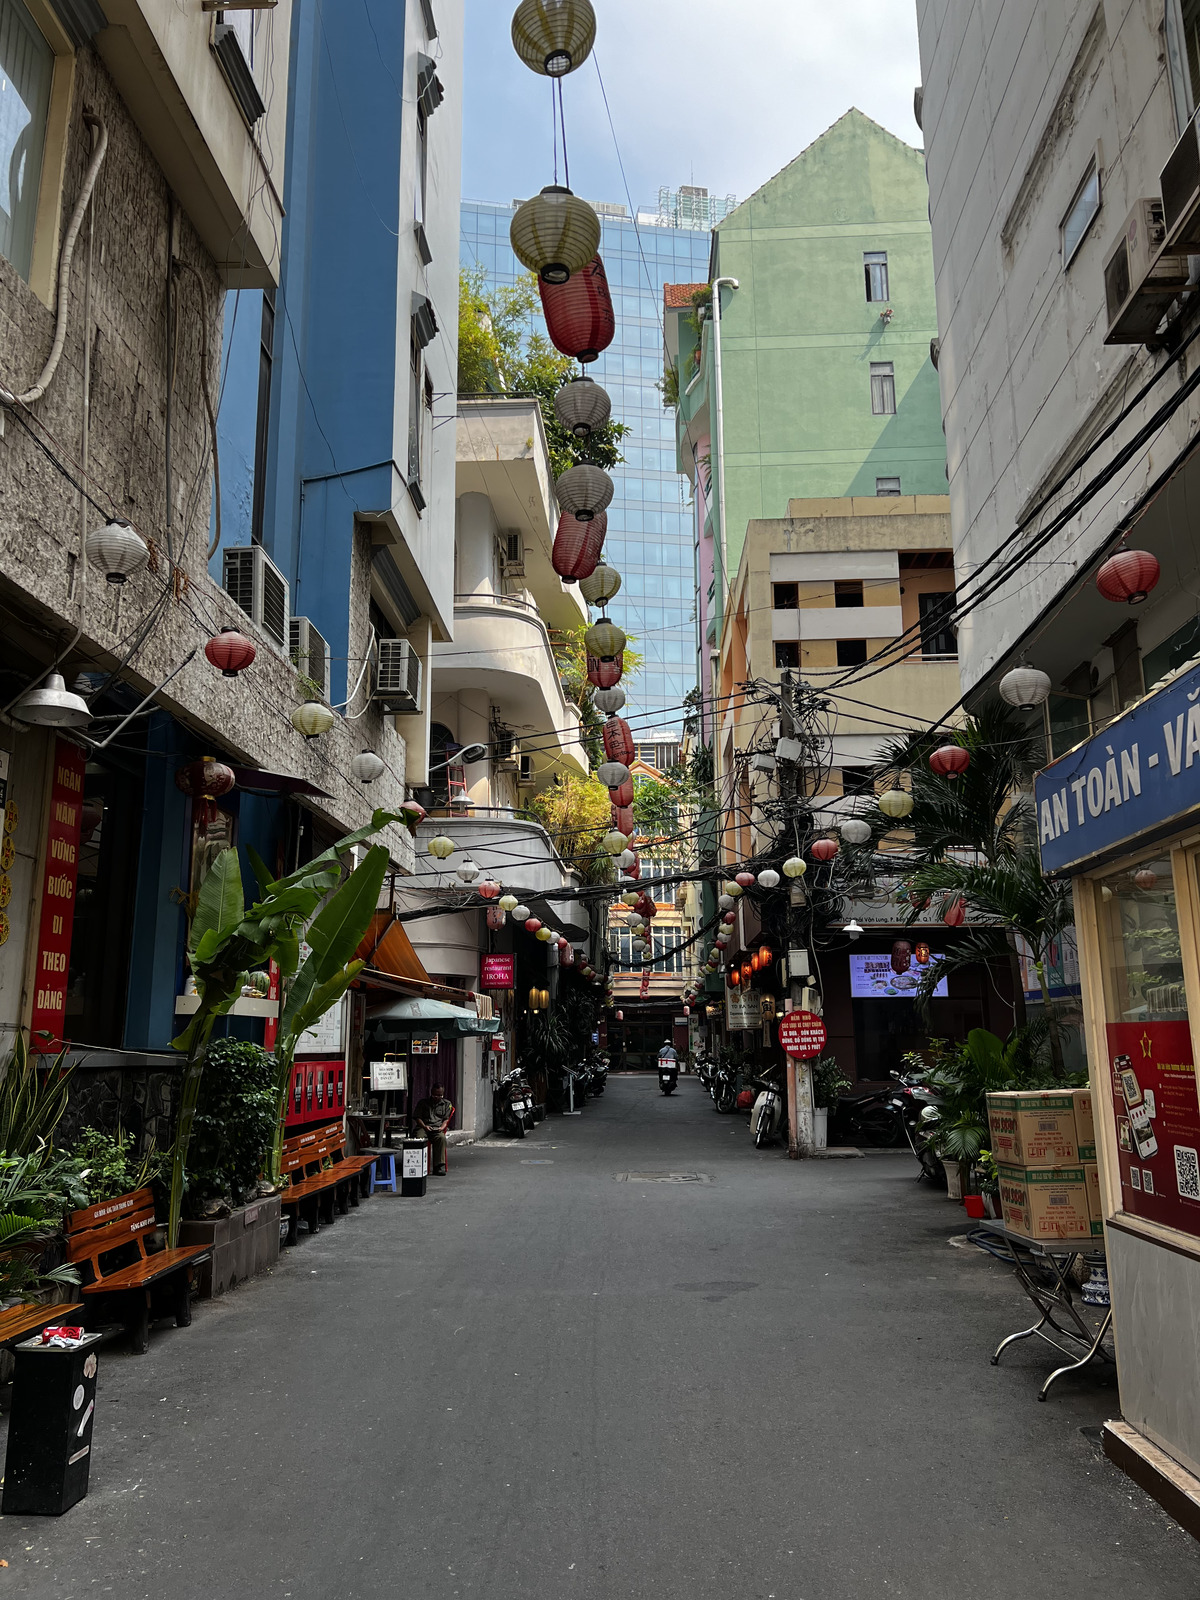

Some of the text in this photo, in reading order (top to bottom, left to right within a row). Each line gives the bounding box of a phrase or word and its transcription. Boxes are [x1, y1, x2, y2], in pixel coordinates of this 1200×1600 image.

[57, 765, 82, 793] NGÀN
[1040, 787, 1069, 845] AN
[1071, 743, 1141, 826] TOÀN
[55, 802, 76, 828] NĂM
[51, 837, 76, 864] VỮNG
[47, 873, 73, 900] BƯỚC
[52, 914, 63, 936] ĐI
[42, 950, 66, 973] THEO
[37, 984, 63, 1011] ĐẢNG
